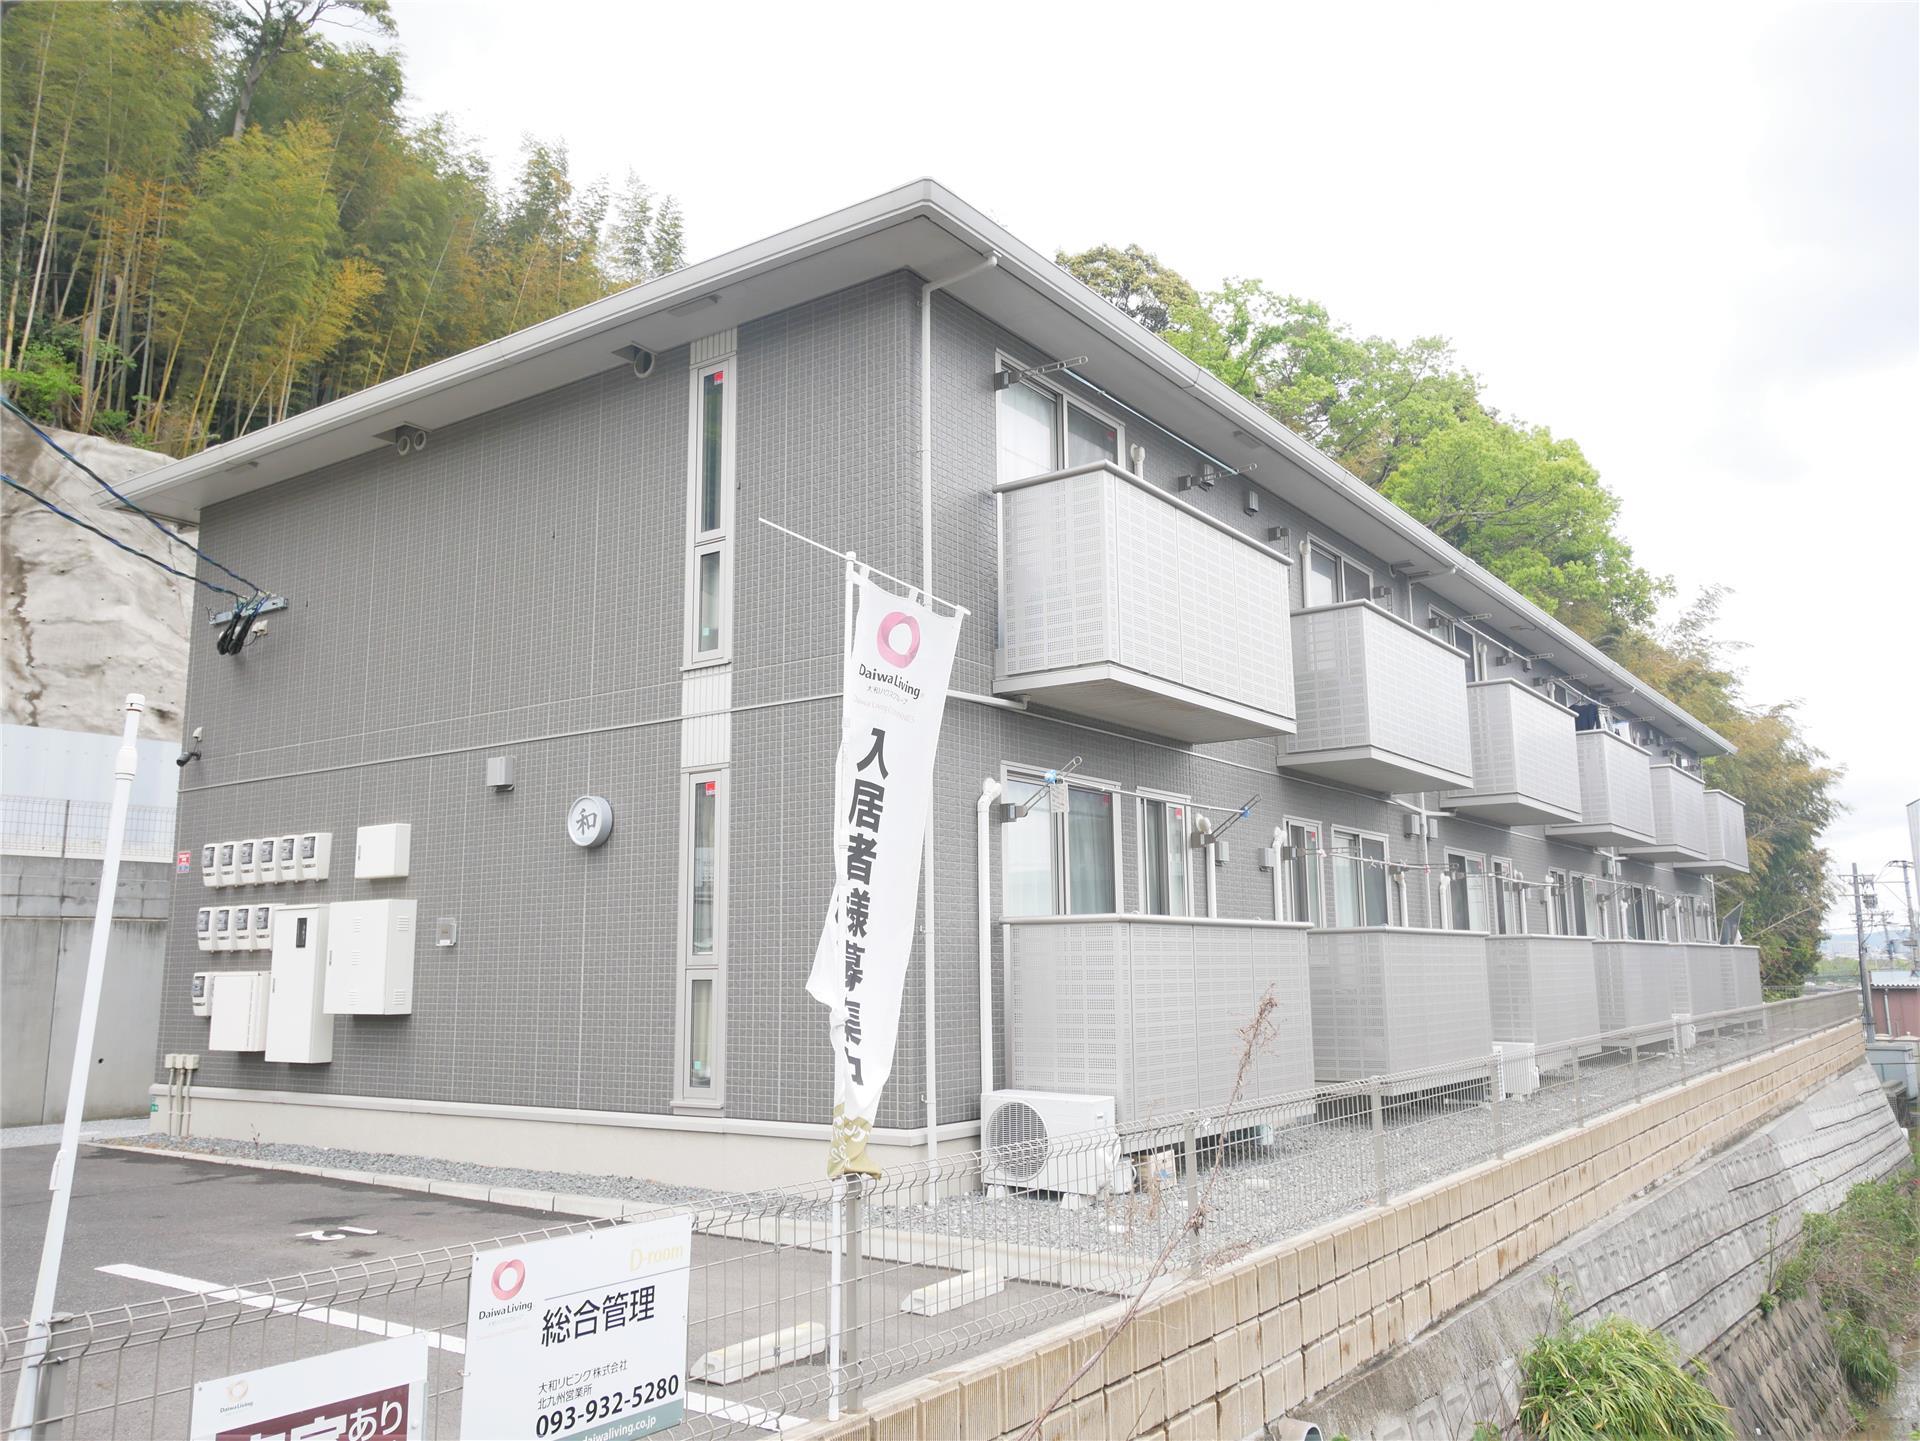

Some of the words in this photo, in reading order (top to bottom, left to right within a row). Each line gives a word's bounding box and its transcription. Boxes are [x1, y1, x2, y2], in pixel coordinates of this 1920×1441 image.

[575, 807, 598, 836] 和
[541, 1285, 655, 1347] 総合管理
[538, 1359, 628, 1395] 大和リビング株式会社
[536, 1374, 679, 1438] 093-932-5280
[537, 1383, 593, 1411] 北九州営業所
